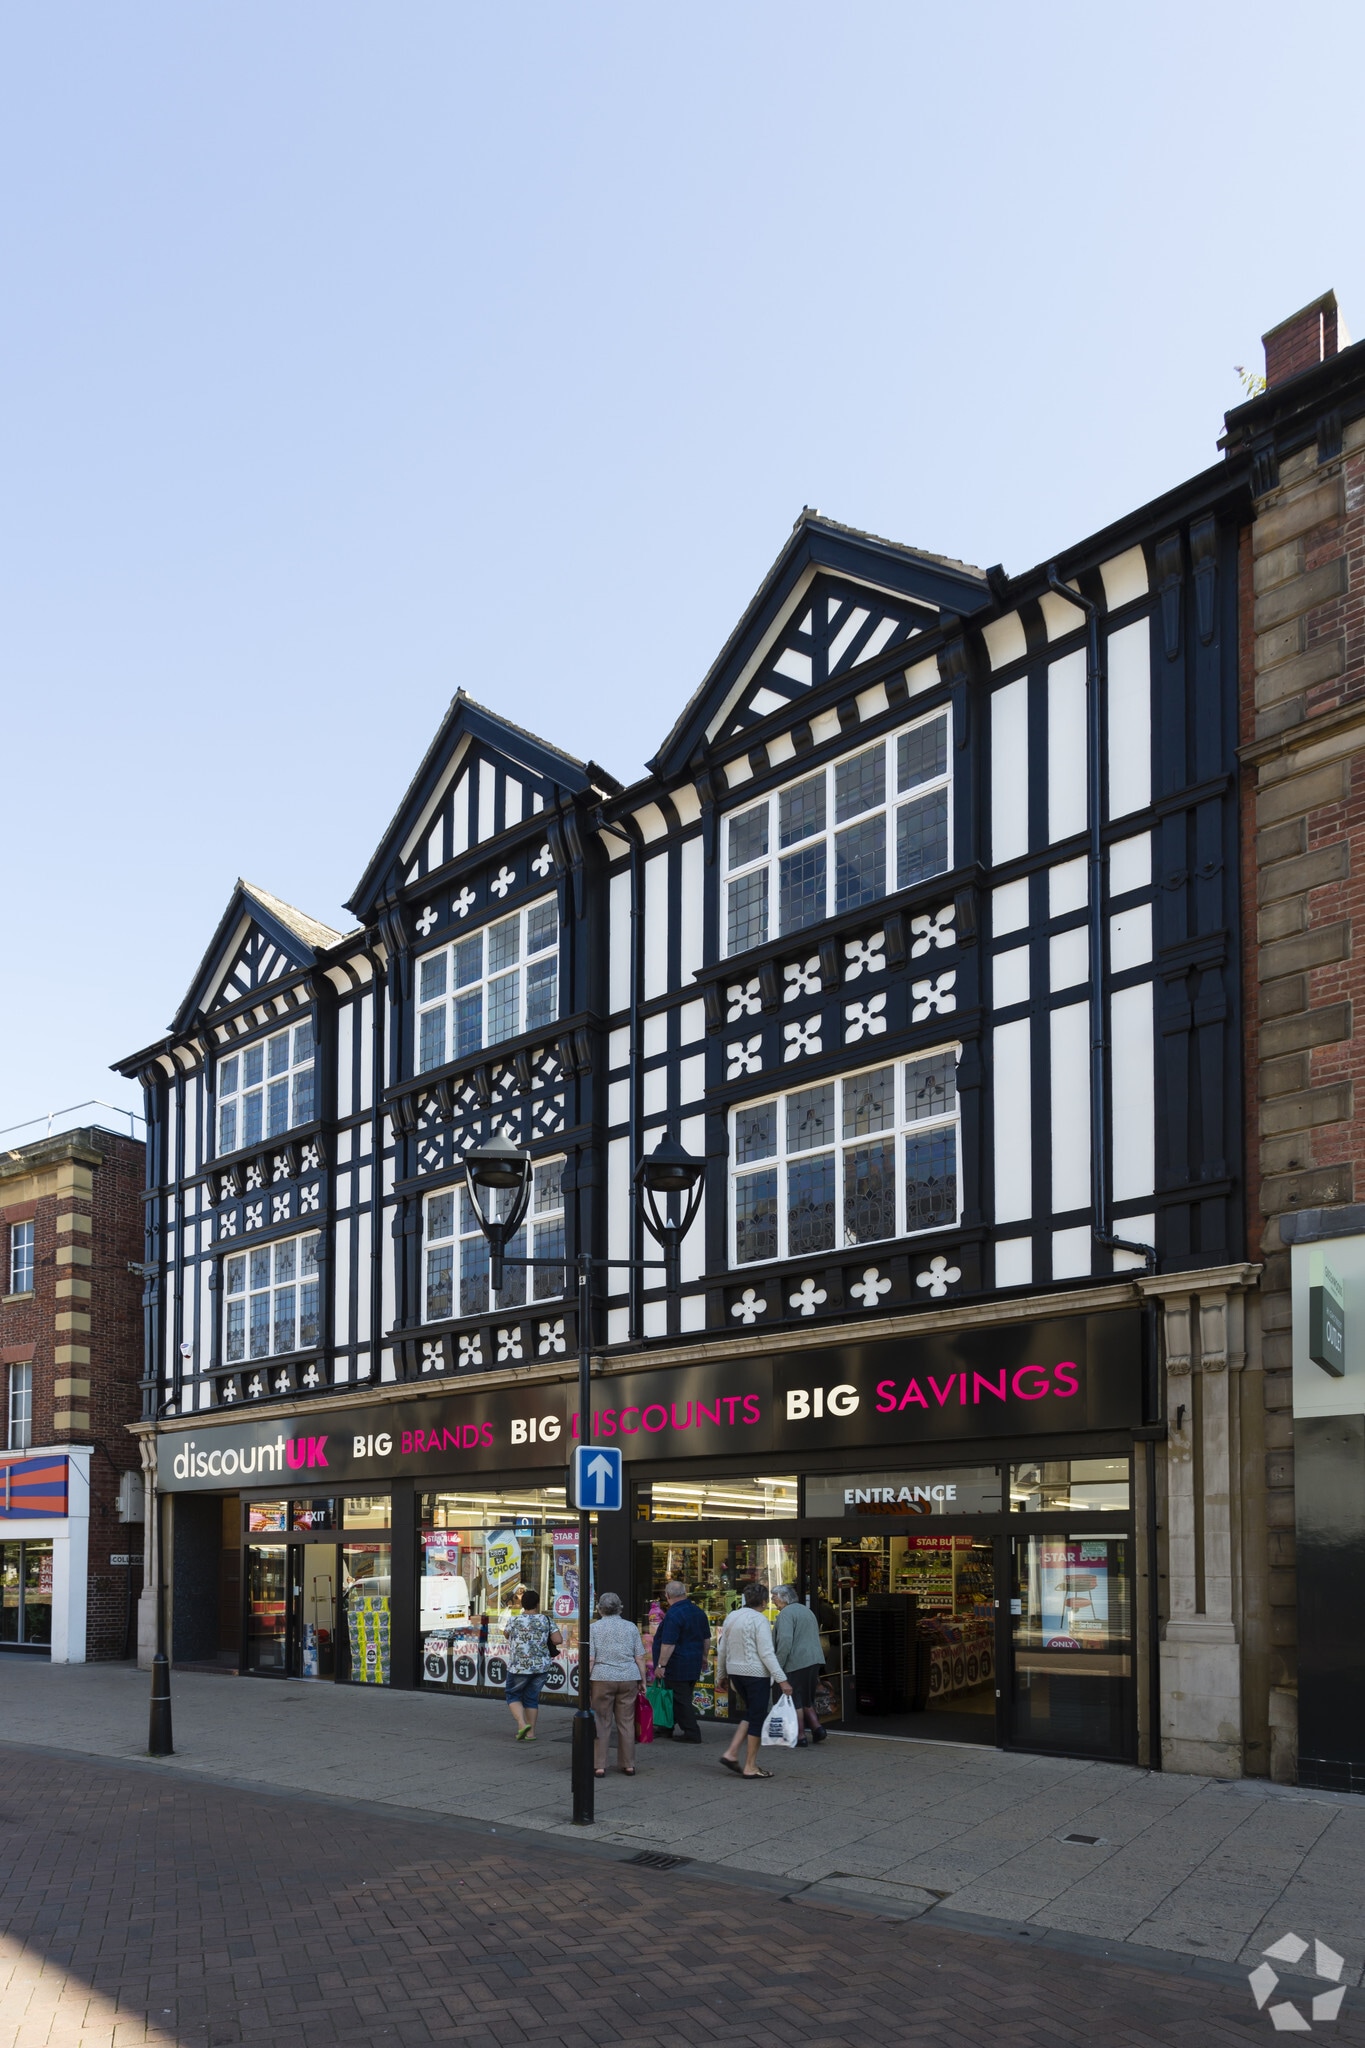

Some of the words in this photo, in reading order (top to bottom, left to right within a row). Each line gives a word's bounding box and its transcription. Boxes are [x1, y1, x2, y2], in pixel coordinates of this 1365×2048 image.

[1326, 1320, 1342, 1353] OUTLET
[353, 1433, 393, 1459] BIG
[401, 1422, 494, 1454] BRANDS
[511, 1415, 561, 1445] BIG
[786, 1384, 860, 1420] BIG
[876, 1361, 1080, 1413] SAVINGS
[173, 1435, 329, 1479] discountUK
[844, 1484, 957, 1505] ENTRANCE
[305, 1510, 326, 1522] EXIT
[554, 1532, 573, 1540] STAR
[916, 1538, 938, 1546] STAR
[939, 1538, 953, 1546] BU
[490, 1549, 507, 1557] back
[1043, 1552, 1076, 1562] STAR
[41, 1566, 53, 1574] SAL
[41, 1575, 53, 1584] SAL
[40, 1584, 53, 1593] SAL
[558, 1604, 570, 1614] £1
[429, 1662, 440, 1675] £1
[459, 1665, 469, 1678] £1
[491, 1667, 502, 1681] £1
